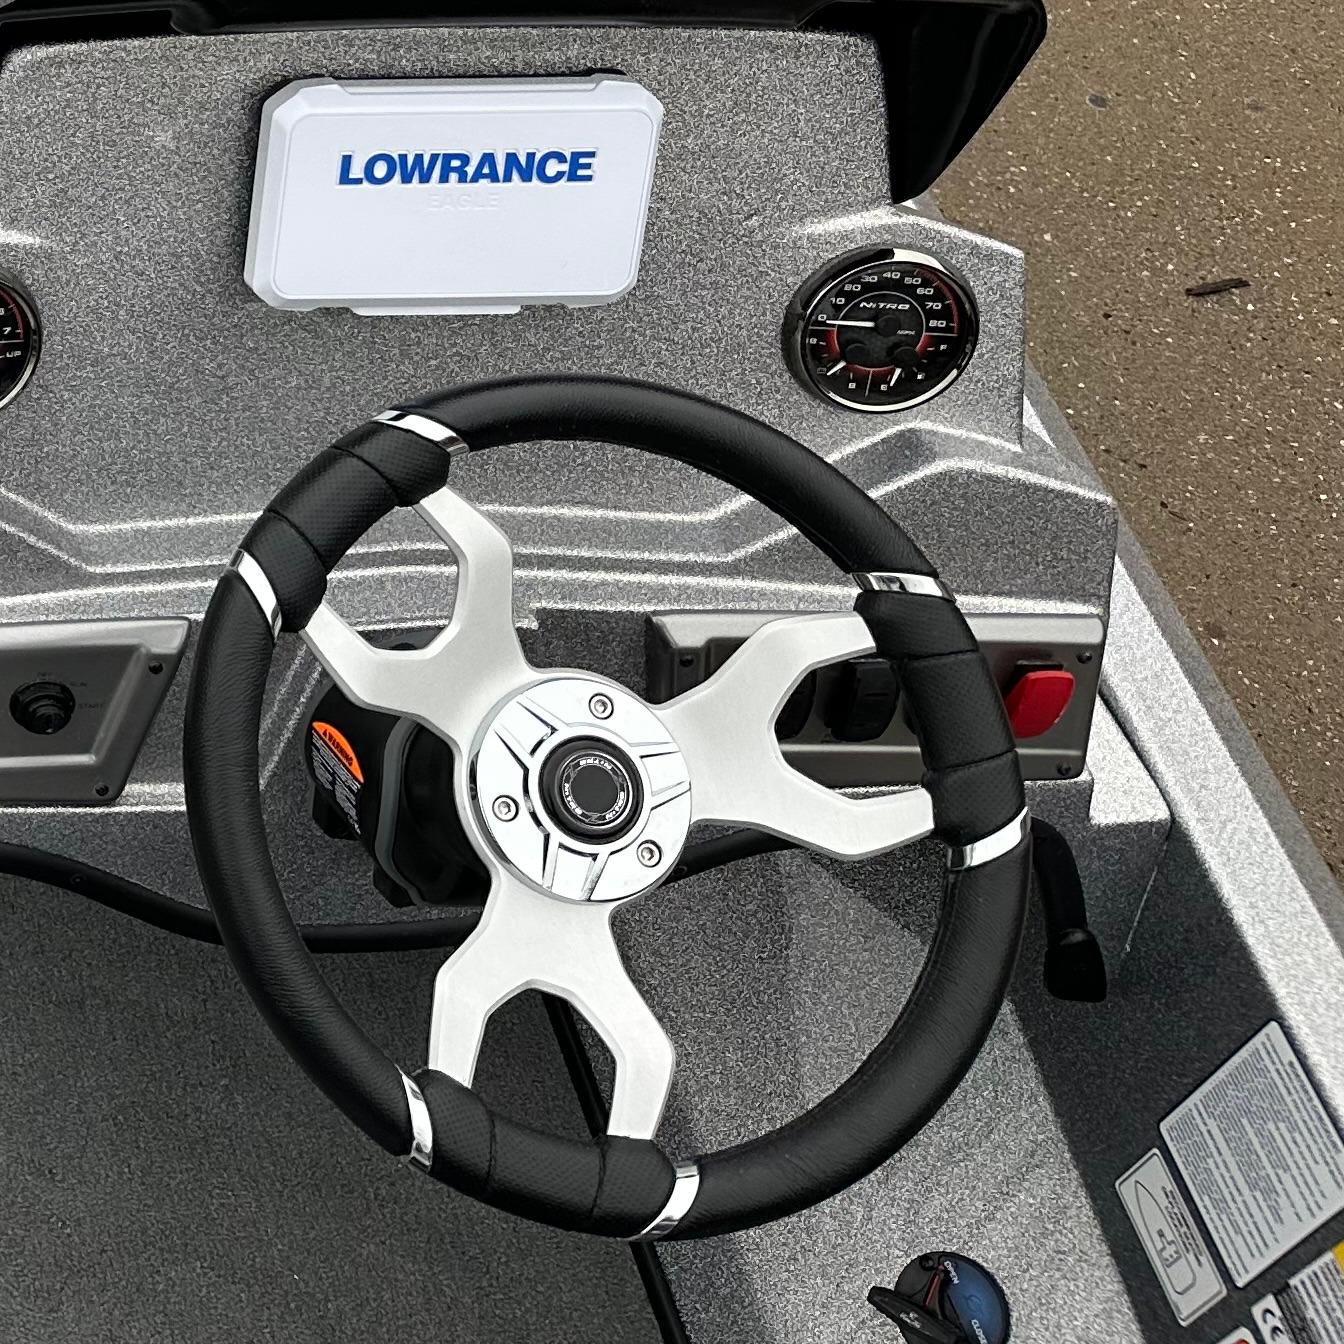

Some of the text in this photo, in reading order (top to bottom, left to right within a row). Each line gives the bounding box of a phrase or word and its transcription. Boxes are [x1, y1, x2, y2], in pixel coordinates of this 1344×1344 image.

[339, 151, 596, 185] LOWRANCE
[428, 191, 501, 211] EAGLE
[944, 1260, 960, 1284] OPEN
